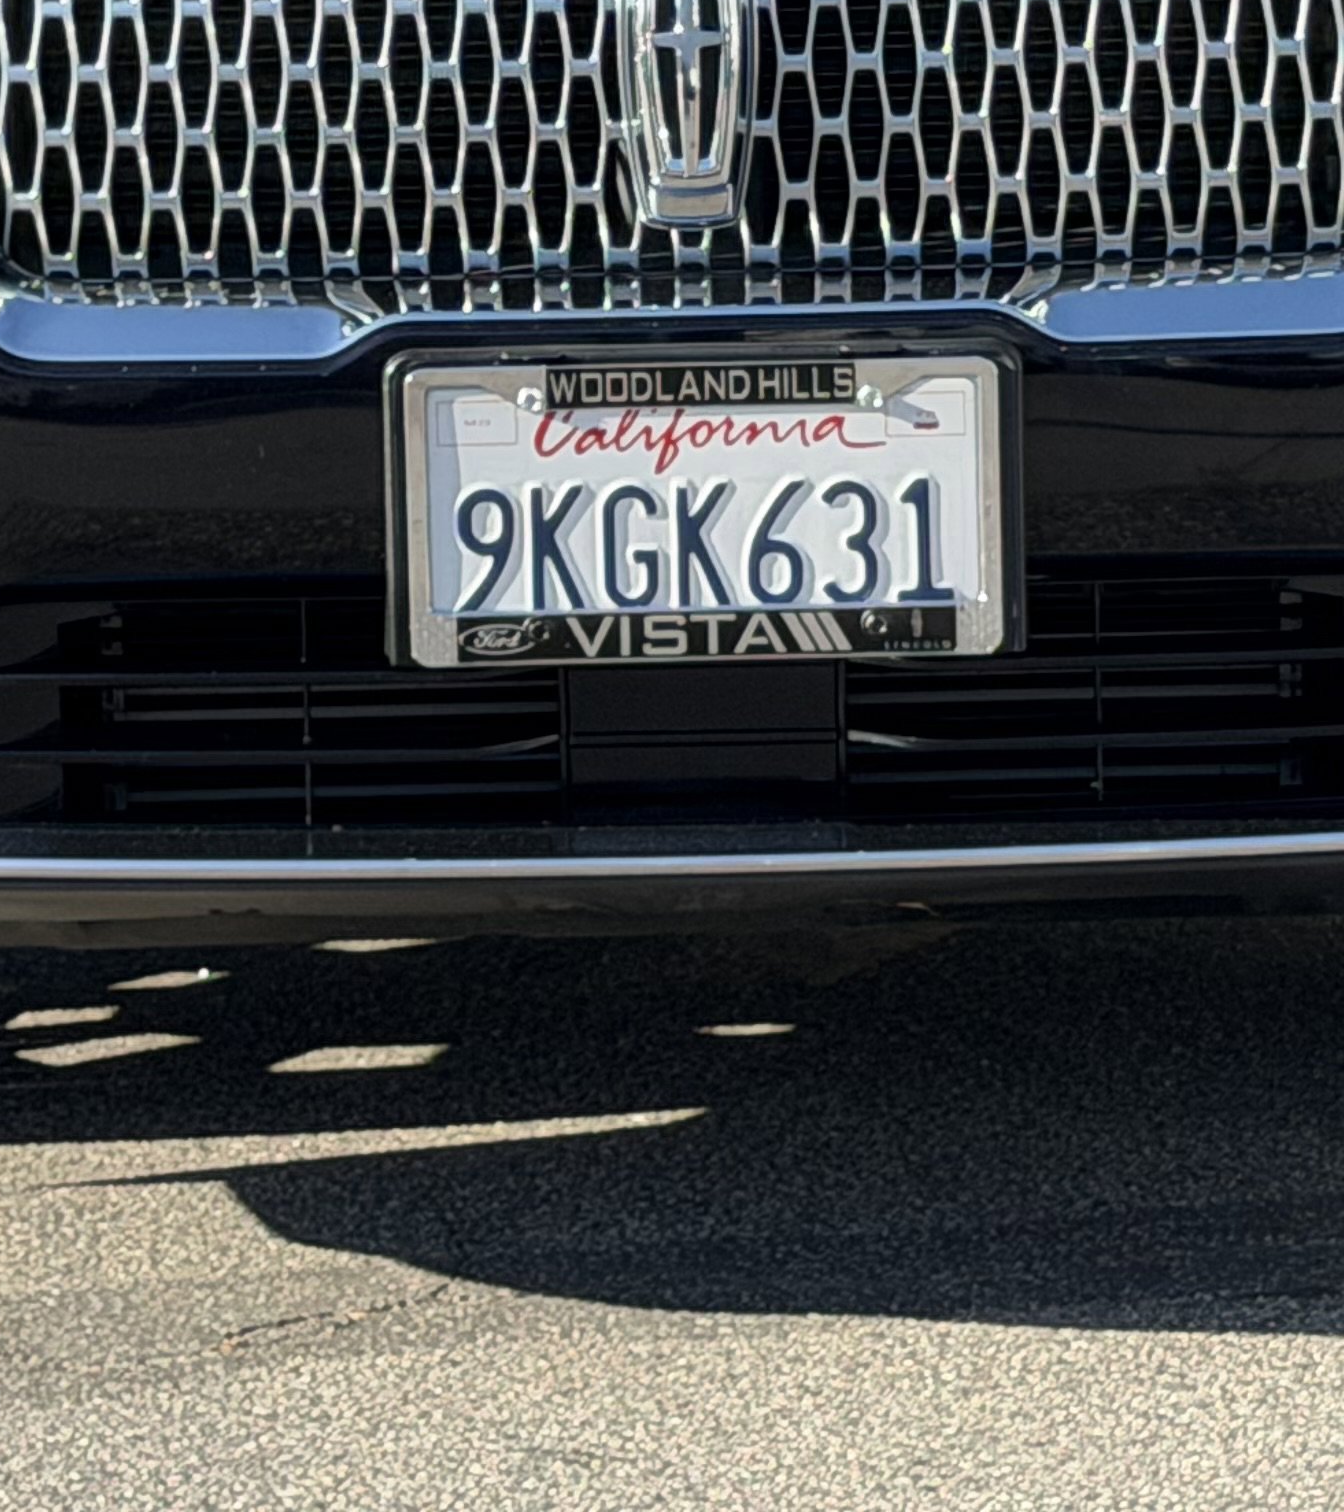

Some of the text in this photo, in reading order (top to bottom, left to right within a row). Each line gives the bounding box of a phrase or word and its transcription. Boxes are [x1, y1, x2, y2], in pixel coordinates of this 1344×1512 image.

[550, 367, 854, 404] WOODLAND HILLS
[533, 408, 887, 474] California
[455, 478, 955, 611] 9KGK631
[472, 616, 785, 657] Ford VISTA
